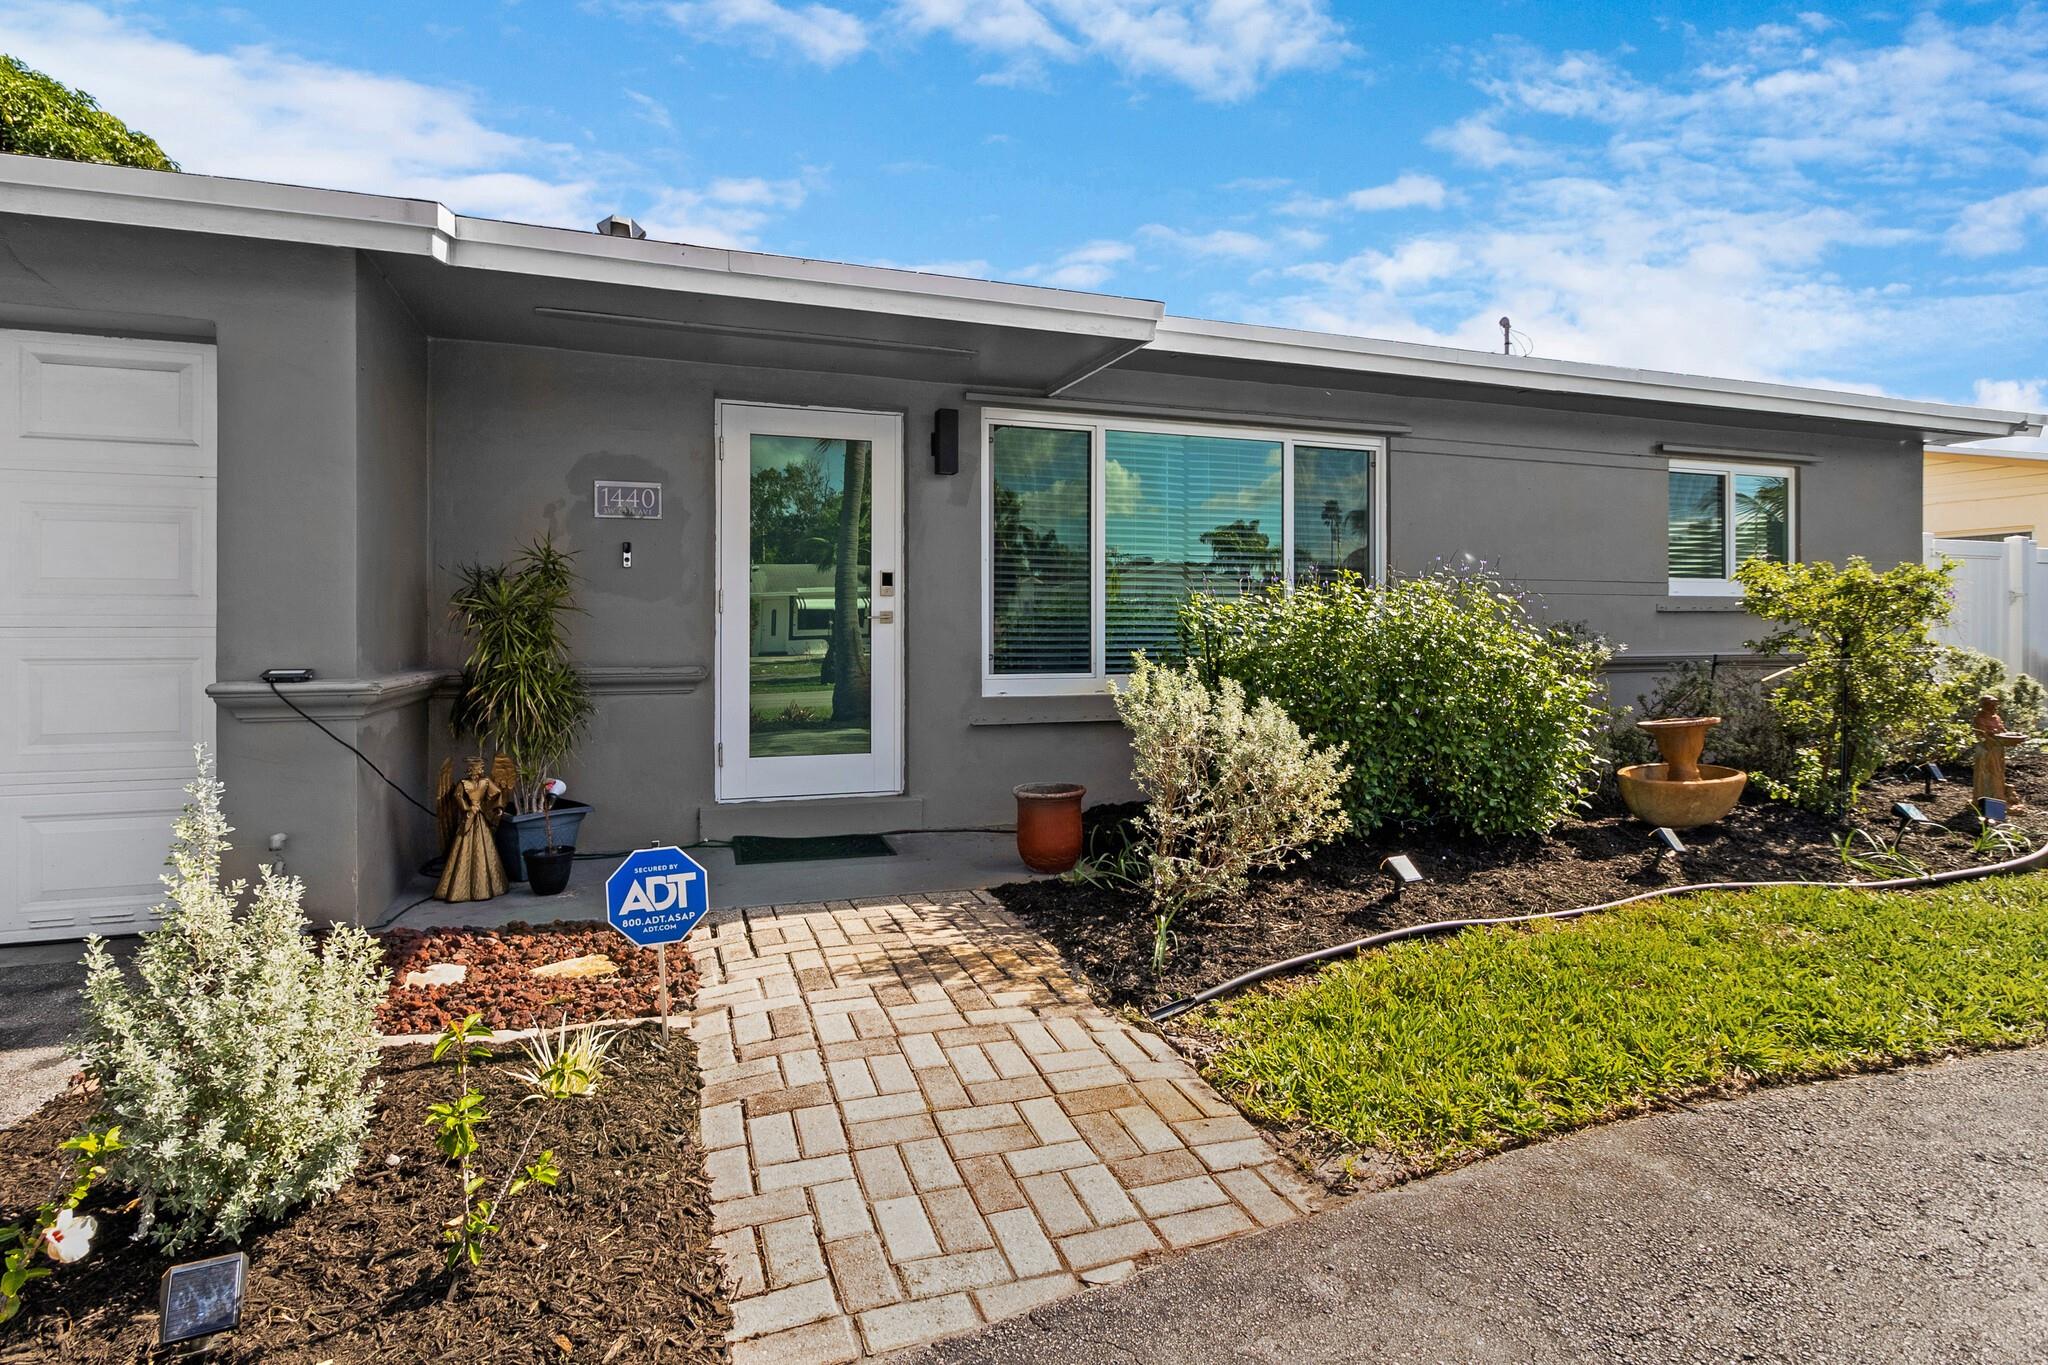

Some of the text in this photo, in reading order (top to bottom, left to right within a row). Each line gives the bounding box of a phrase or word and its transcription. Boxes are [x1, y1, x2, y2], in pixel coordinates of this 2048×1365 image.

[601, 487, 655, 509] 1440
[634, 865, 667, 874] SECURED
[618, 871, 697, 916] ADT
[622, 911, 696, 928] 800.ADT.ASAP
[643, 923, 677, 933] ADT.COM
